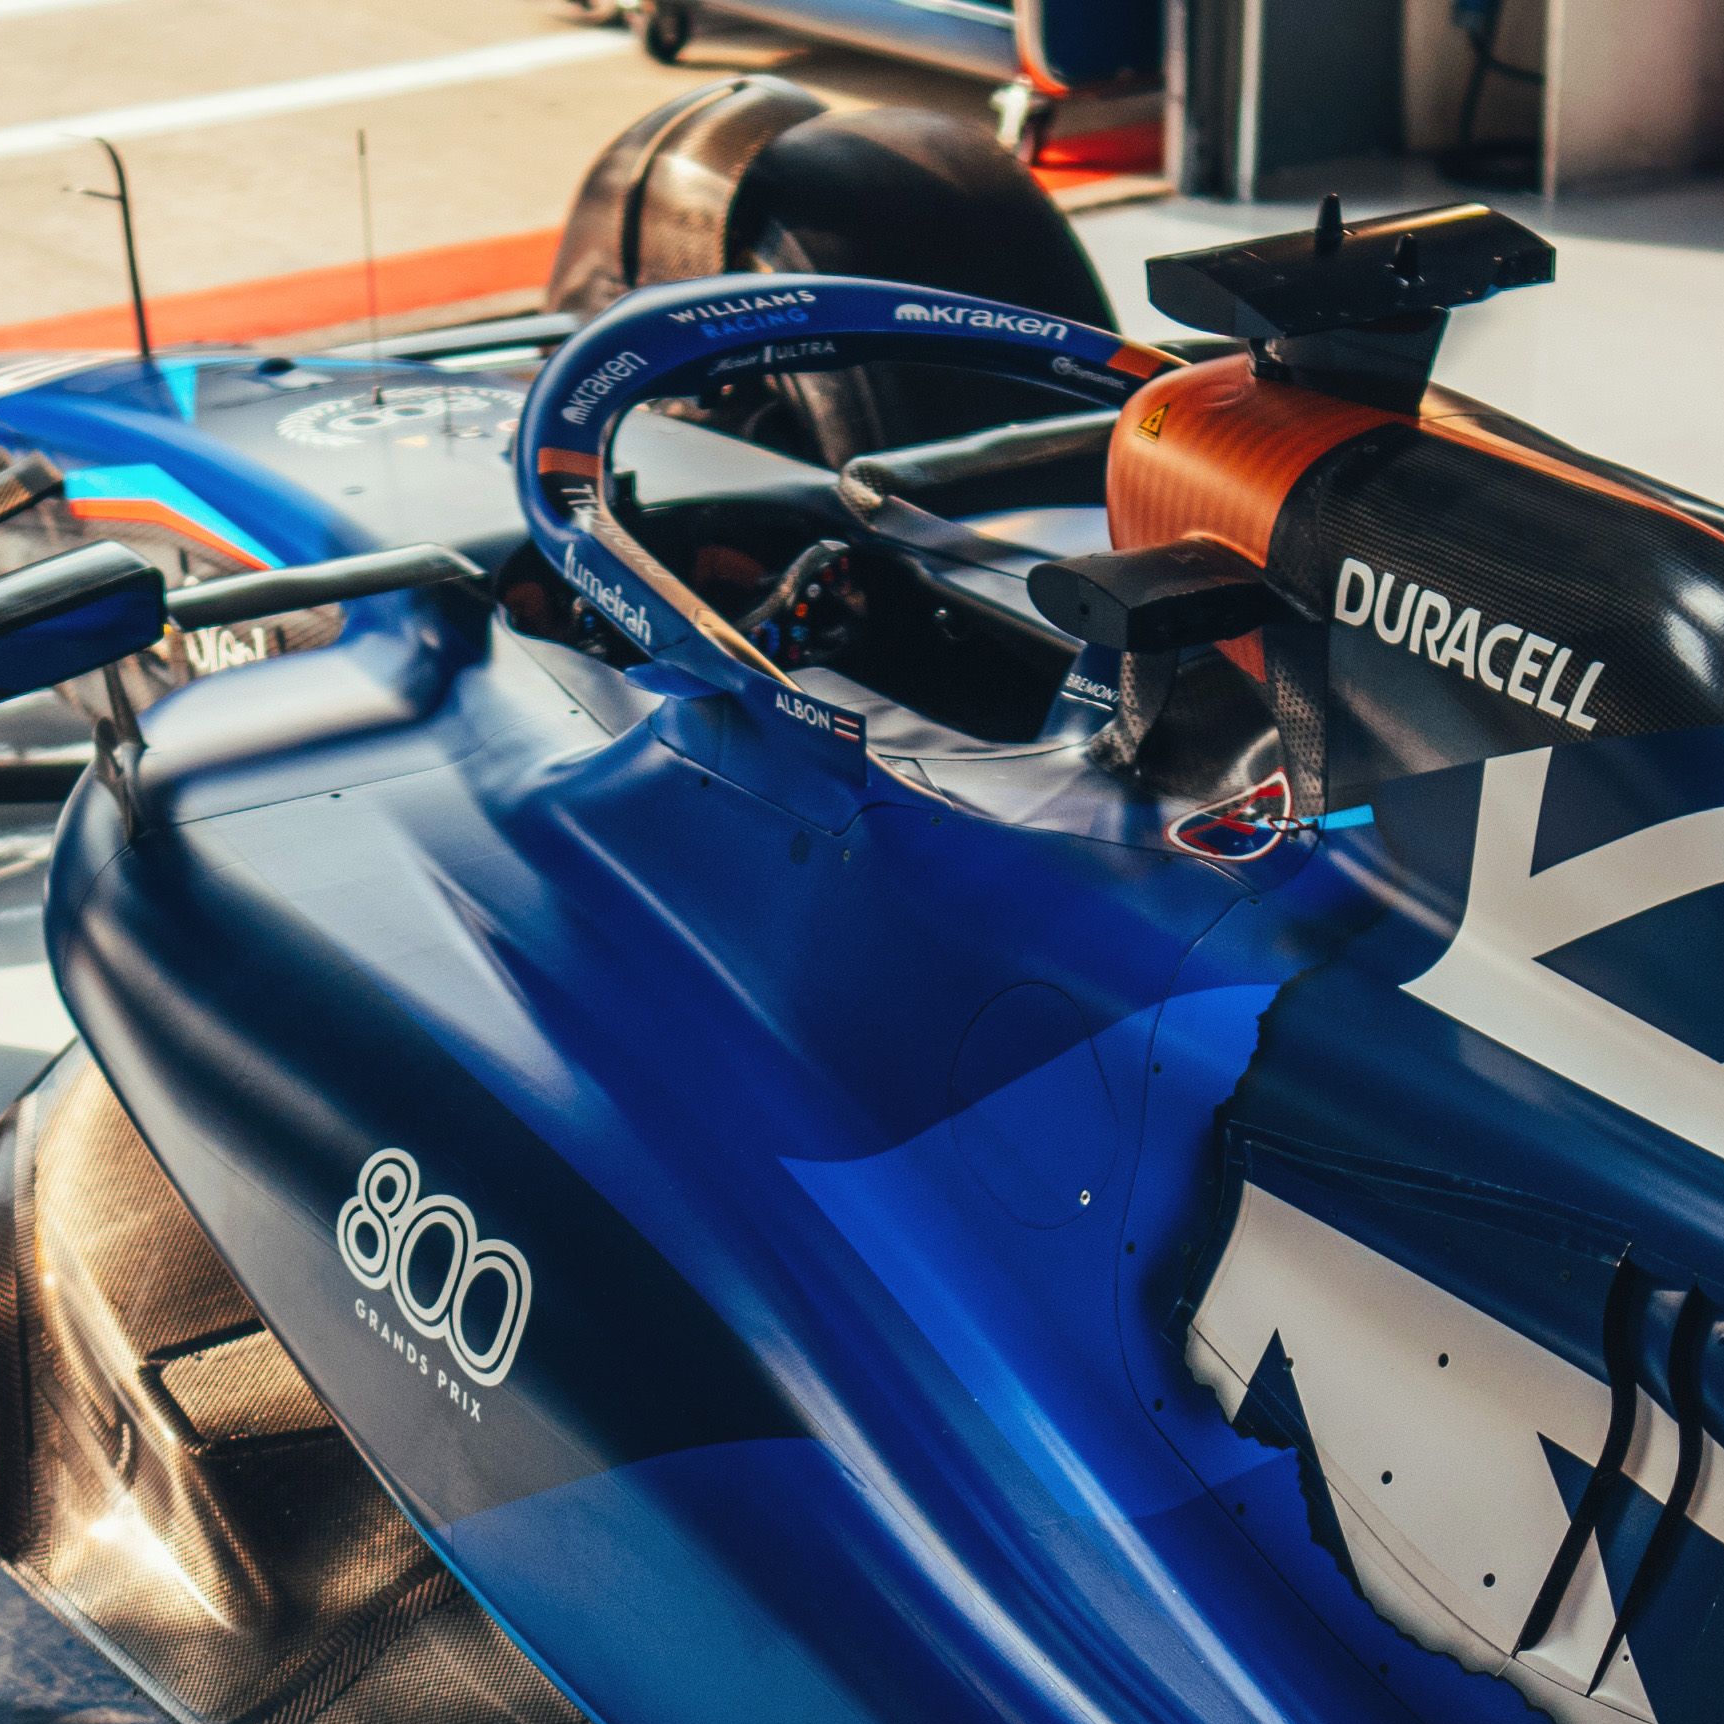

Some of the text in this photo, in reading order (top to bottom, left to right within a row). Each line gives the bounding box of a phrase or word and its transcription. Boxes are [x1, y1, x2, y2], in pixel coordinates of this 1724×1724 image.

[667, 290, 818, 324] WILLIAMS
[700, 307, 810, 339] RACING
[1334, 556, 1606, 733] DURACELL
[775, 691, 832, 732] ALBON
[335, 1146, 533, 1388] 800
[353, 1296, 482, 1425] GRANDS PRIX
